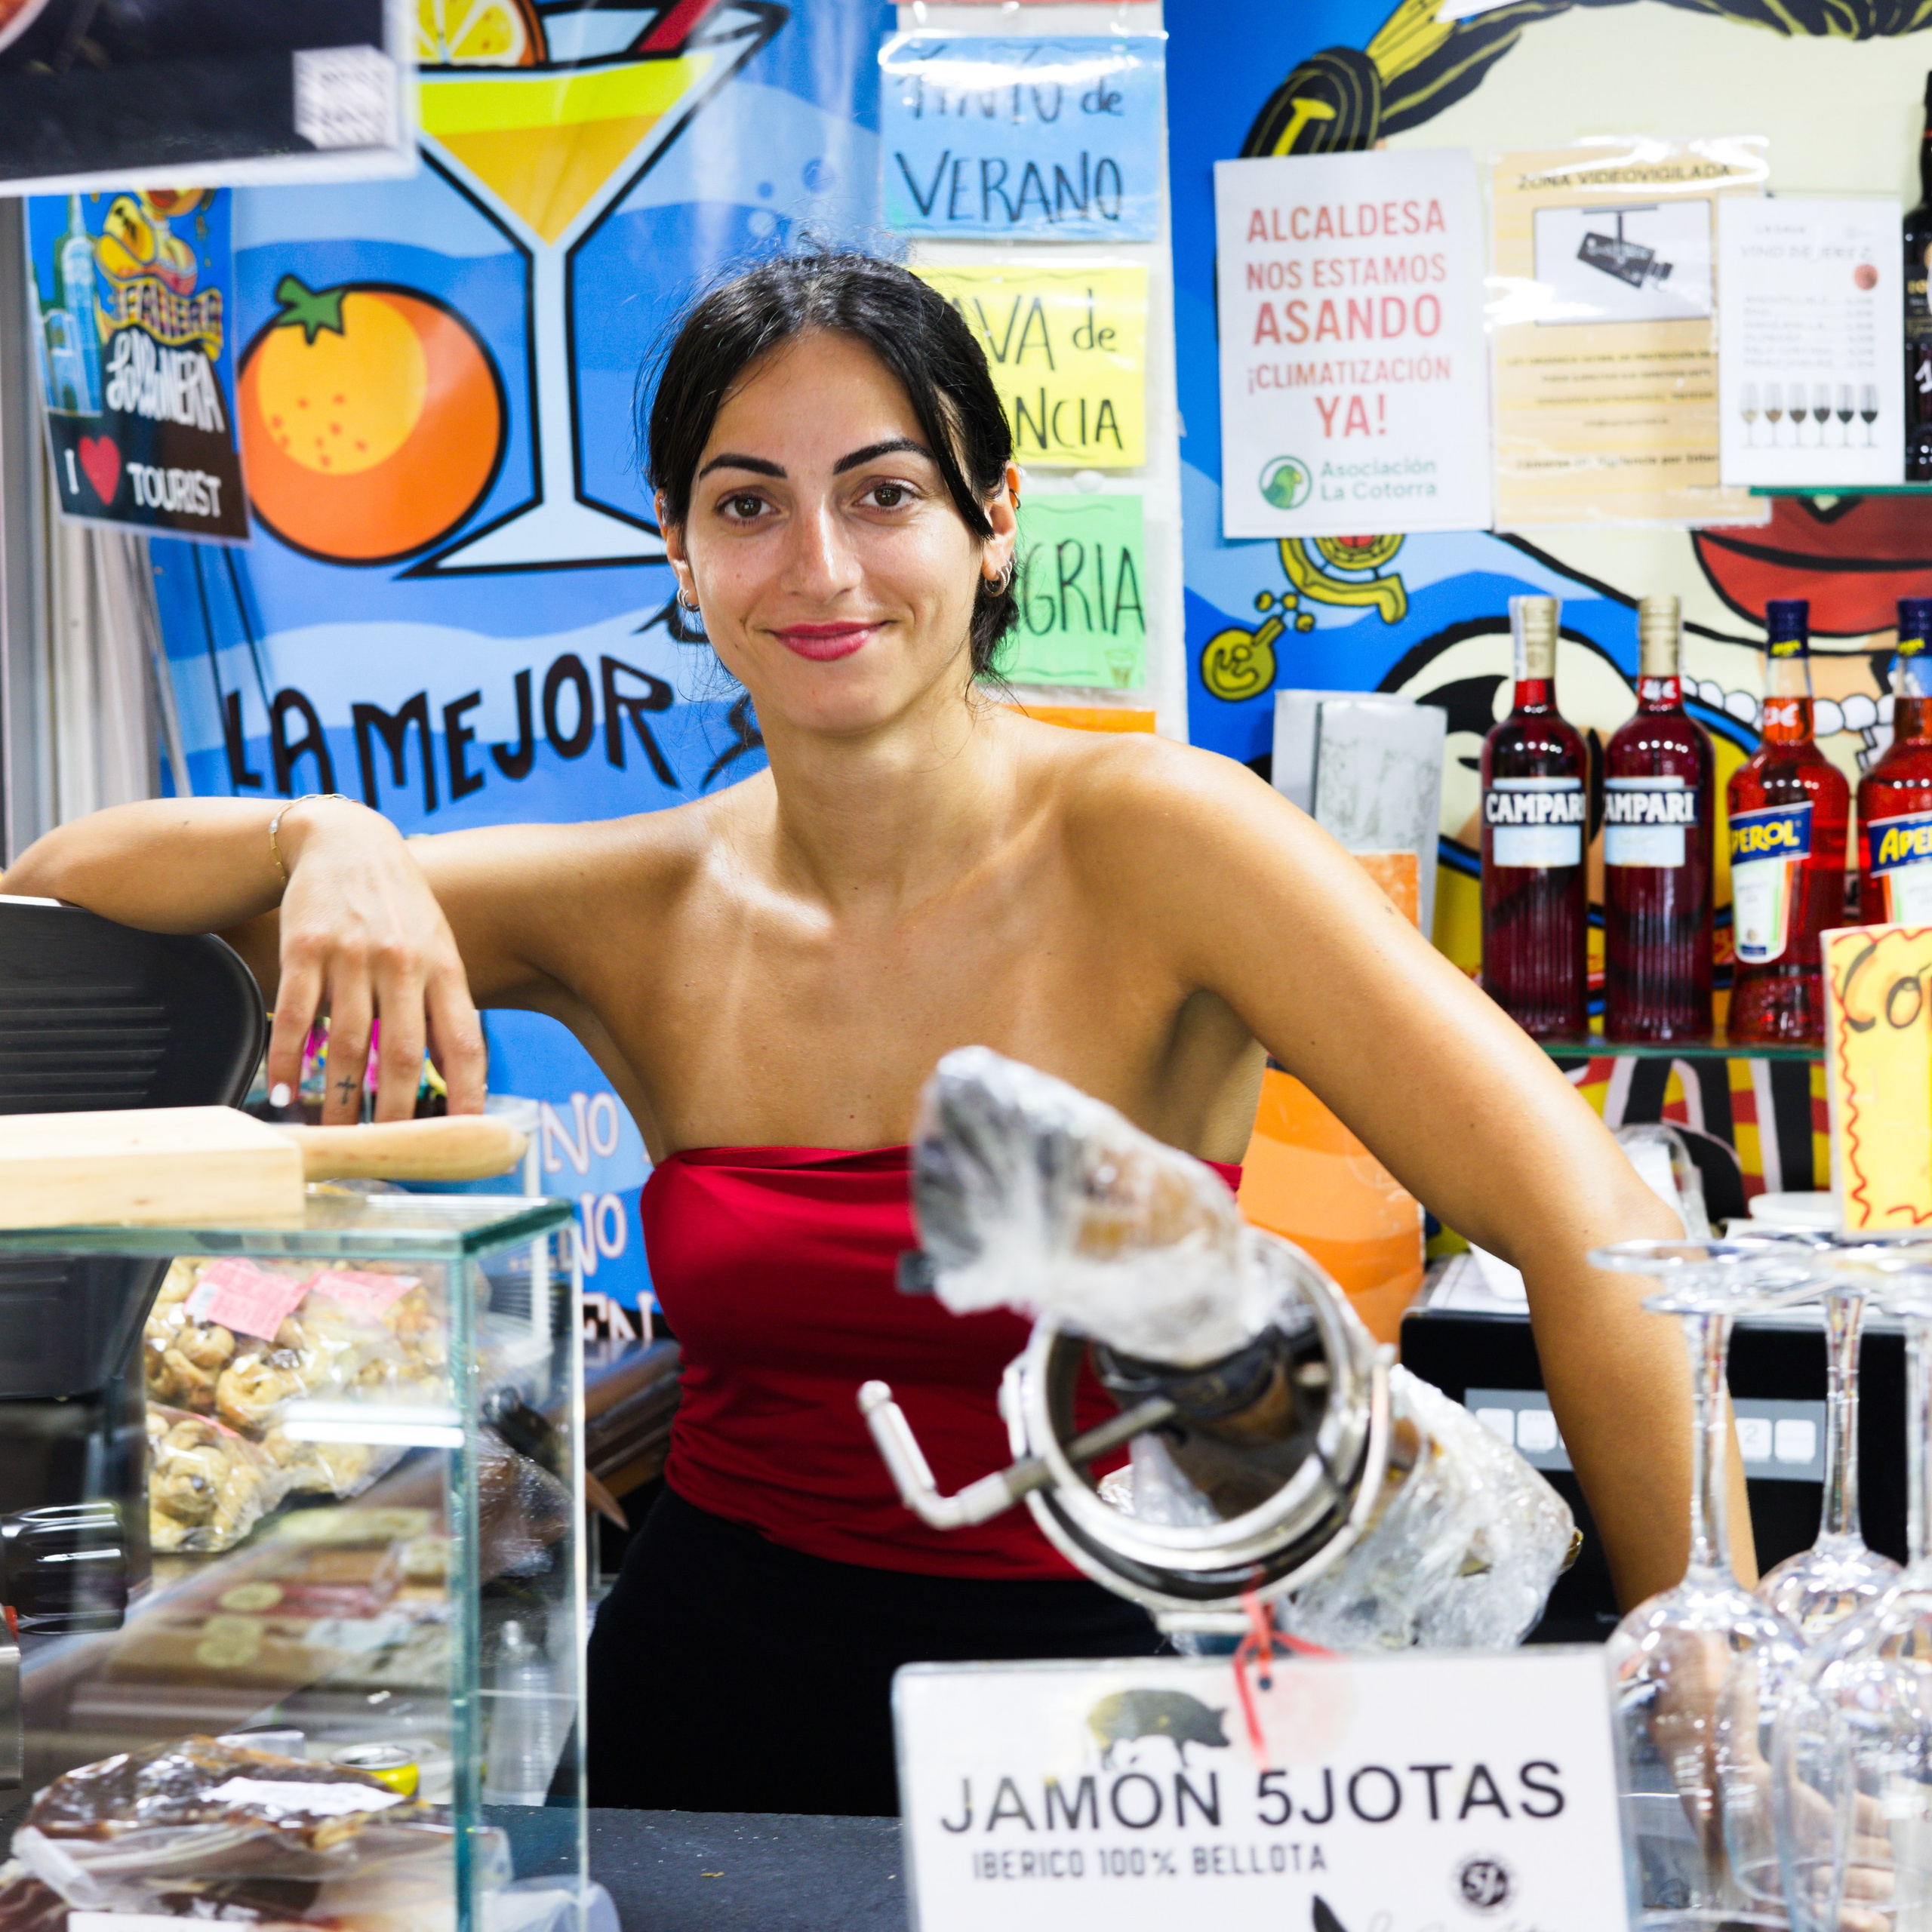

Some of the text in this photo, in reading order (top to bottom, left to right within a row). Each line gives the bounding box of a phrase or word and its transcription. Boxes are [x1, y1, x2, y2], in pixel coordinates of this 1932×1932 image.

[1080, 75, 1124, 116] de
[894, 149, 1123, 223] VERANO
[1247, 199, 1447, 242] ALCALDESA
[1246, 254, 1447, 291] NOS ESTAMOS
[949, 288, 1118, 371] VA de
[1253, 294, 1442, 346] ASANDO
[1247, 355, 1451, 394] ¡CLIMATIZACIÓN
[1315, 393, 1388, 438] YA!
[65, 448, 223, 518] I TOURIST
[1321, 457, 1436, 478] Asociación
[1321, 479, 1438, 501] La Cotorra
[226, 688, 337, 797] LA
[352, 652, 681, 815] MEJOR
[1878, 828, 1932, 865] APE
[1841, 942, 1932, 1033] Co
[940, 1755, 1566, 1834] JAMÓN 5JOTAS
[973, 1842, 1329, 1881] IBERICO 100% BELLOTA
